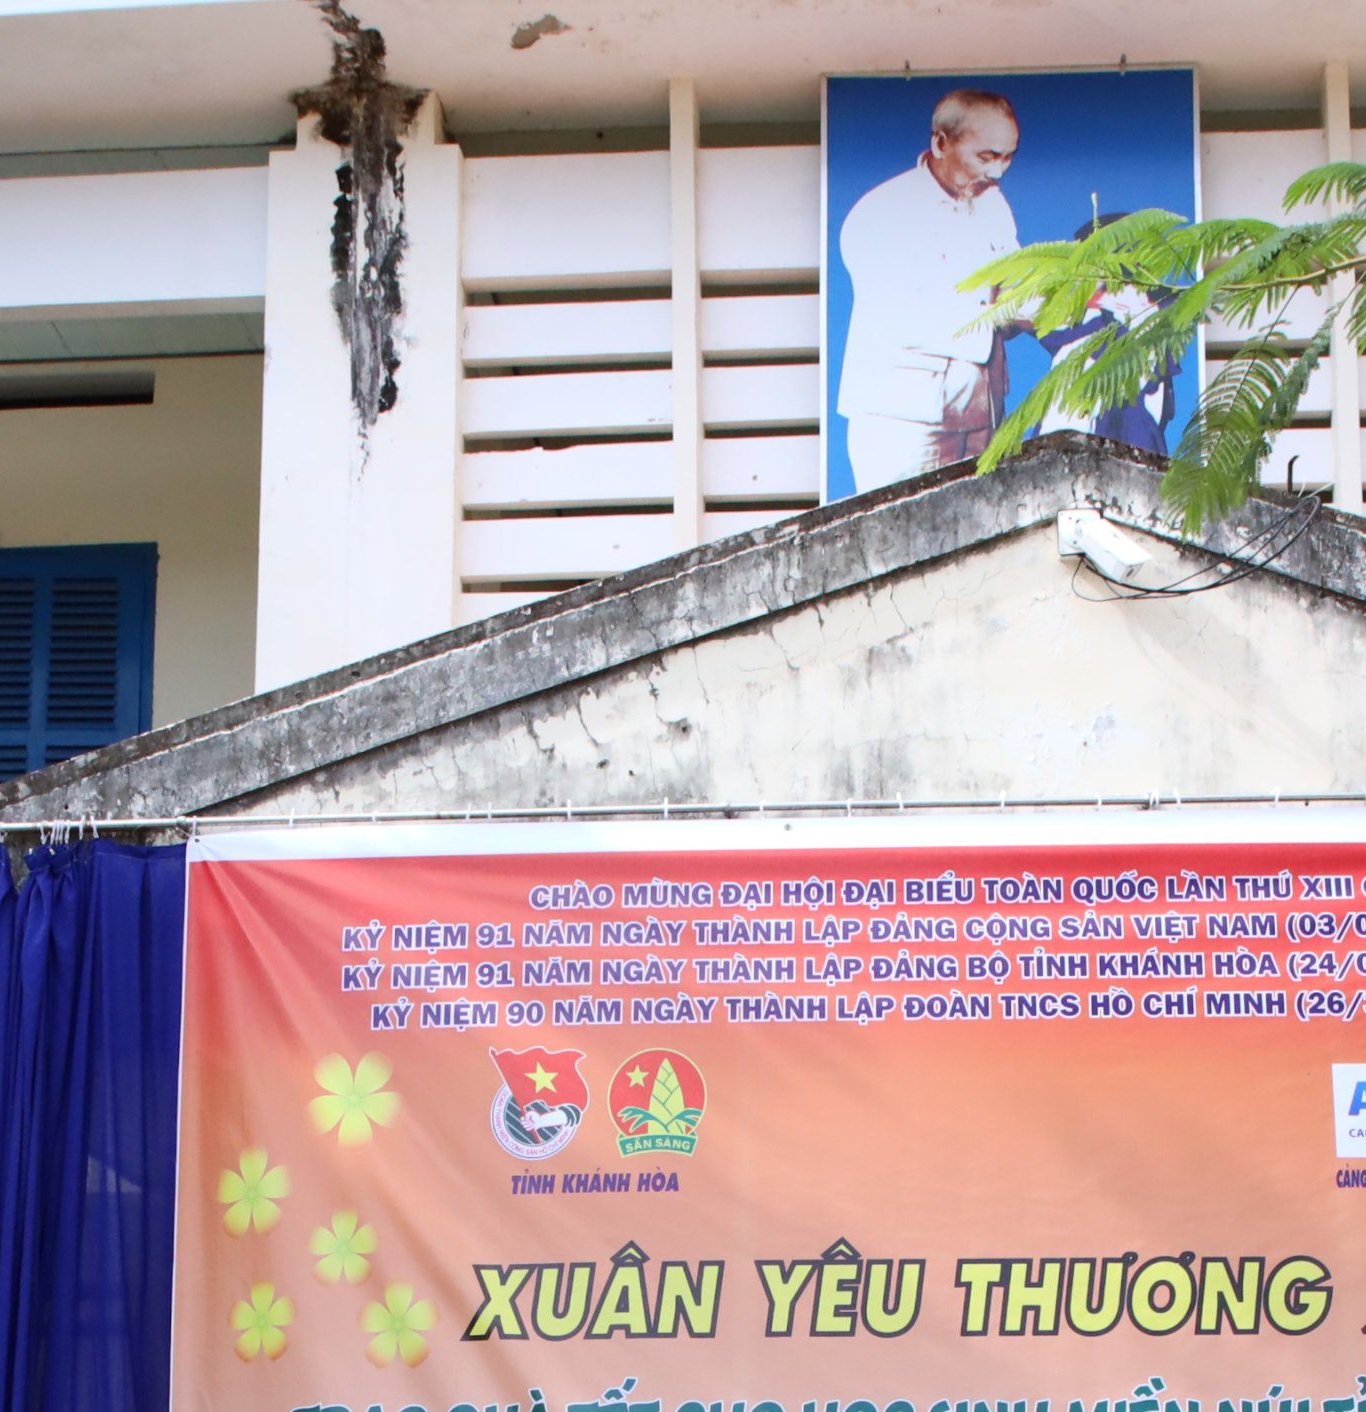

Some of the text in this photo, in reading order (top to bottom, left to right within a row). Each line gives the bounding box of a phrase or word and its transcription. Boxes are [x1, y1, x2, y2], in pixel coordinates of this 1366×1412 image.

[530, 880, 613, 909] CHÀO
[623, 878, 713, 908] MỪNG
[720, 882, 773, 909] ĐẠI
[782, 877, 835, 909] HỘI
[843, 881, 895, 909] ĐẠI
[904, 871, 973, 903] BIỂU
[983, 872, 1063, 903] TOÀN
[1072, 871, 1158, 906] QUỐC
[1167, 870, 1225, 901] LẦN
[1234, 870, 1291, 901] THỨ
[1300, 876, 1354, 899] XIII
[342, 919, 385, 952] KỶ
[393, 922, 468, 954] NIỆM
[476, 923, 514, 947] 91
[523, 920, 593, 946] NĂM
[601, 916, 687, 946] NGÀY
[693, 915, 794, 945] THÀNH
[804, 915, 862, 946] LẬP
[869, 912, 956, 944] ĐẢNG
[964, 913, 1051, 945] CỘNG
[1059, 911, 1124, 939] SẢN
[1132, 911, 1199, 942] VIỆT
[1206, 913, 1277, 938] NAM
[341, 958, 384, 991] KỶ
[391, 961, 468, 992] NIỆM
[476, 962, 514, 986] 91
[523, 958, 593, 986] NĂM
[601, 954, 686, 985] NGÀY
[694, 953, 795, 982] THÀNH
[804, 953, 863, 986] LẬP
[871, 950, 958, 981] ĐẢNG
[967, 952, 1011, 984] BỘ
[1018, 948, 1089, 979] TỈNH
[1098, 948, 1204, 978] KHÁNH
[1214, 947, 1279, 978] HÒA
[371, 998, 414, 1031] KỶ
[421, 998, 497, 1032] NIỆM
[506, 1001, 544, 1026] 90
[553, 996, 622, 1025] NĂM
[631, 993, 718, 1024] NGÀY
[725, 991, 827, 1022] THÀNH
[837, 992, 896, 1024] LẬP
[903, 989, 991, 1020] ĐOÀN
[1000, 993, 1080, 1019] TNCS
[1089, 986, 1134, 1019] HỒ
[1142, 986, 1197, 1018] CHÍ
[1205, 991, 1287, 1018] MINH
[511, 1166, 679, 1195] TỈNH KHÁNH HÒA
[460, 1239, 726, 1341] XUÂN
[755, 1236, 926, 1339] YÊU
[955, 1250, 1333, 1338] THƯƠNG
